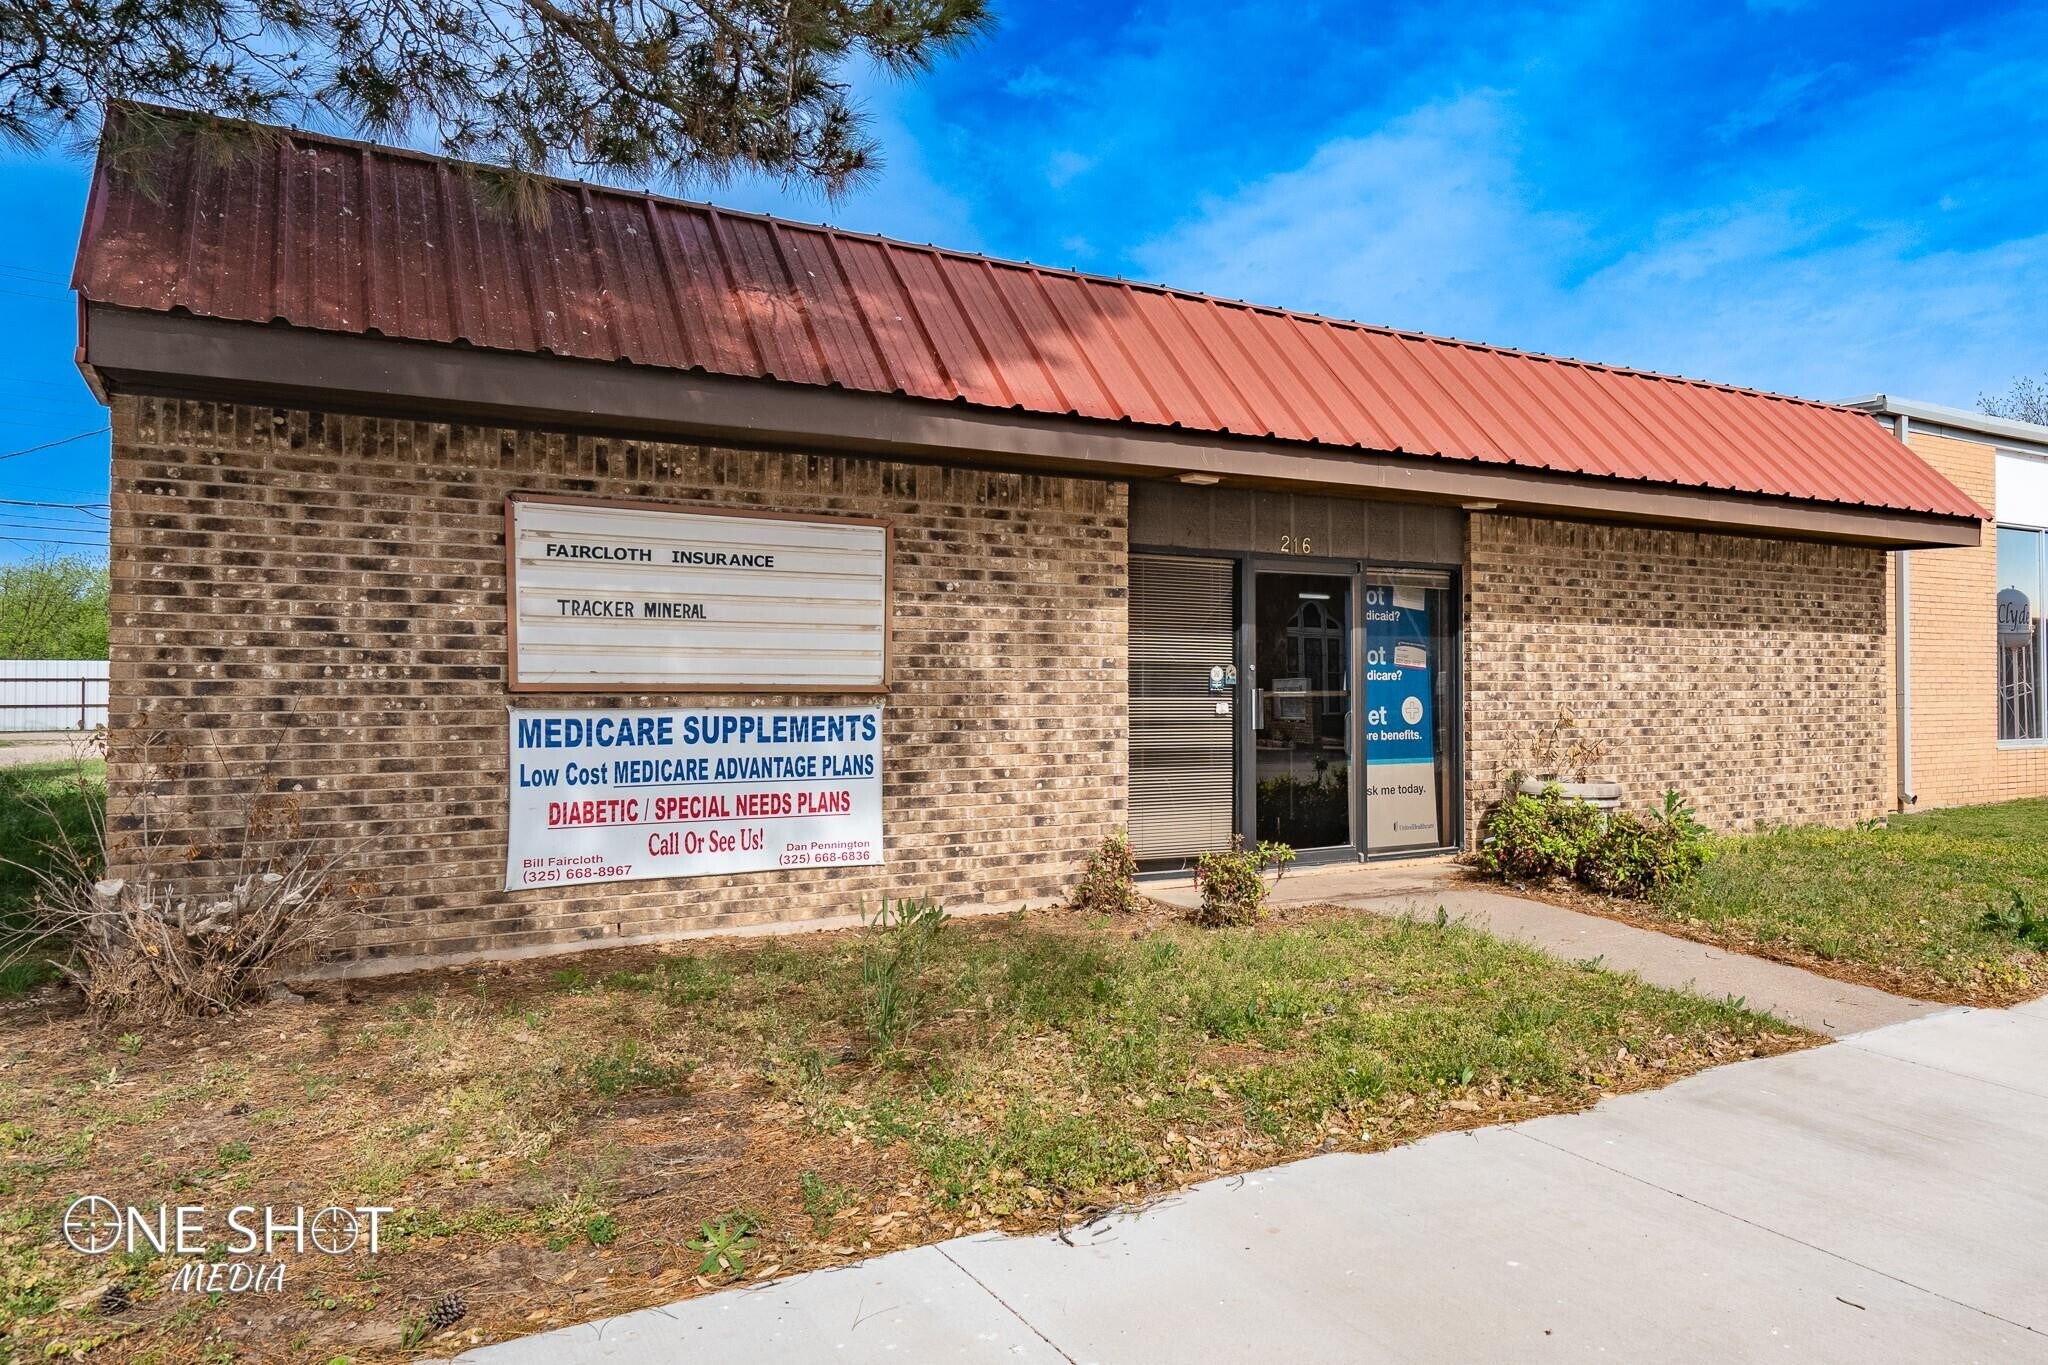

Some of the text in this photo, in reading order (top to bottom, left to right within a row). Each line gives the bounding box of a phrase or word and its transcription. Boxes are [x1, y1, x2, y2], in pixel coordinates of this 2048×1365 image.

[1280, 535, 1311, 554] 216
[546, 543, 775, 568] FAIRCLOTH INSURANCE
[557, 599, 707, 619] TRACKER MINERAL
[1998, 602, 2029, 631] Clyde
[518, 714, 876, 749] MEDICARE SUPPLEMENTS
[1380, 729, 1423, 741] benefits.
[519, 753, 874, 788] Low Cost MEDICARE ADVANTAGE PLANS
[1380, 786, 1396, 796] me
[1398, 784, 1426, 796] today.
[549, 790, 851, 826] DIABETIC / SPECIAL NEEDS PLANS
[648, 827, 764, 857] Call Or See Us!
[786, 840, 870, 852] Dan Pennington
[523, 854, 604, 868] Bill Faircloth
[778, 850, 870, 866] (325) 668-6836
[522, 865, 632, 885] (325) 668-8967
